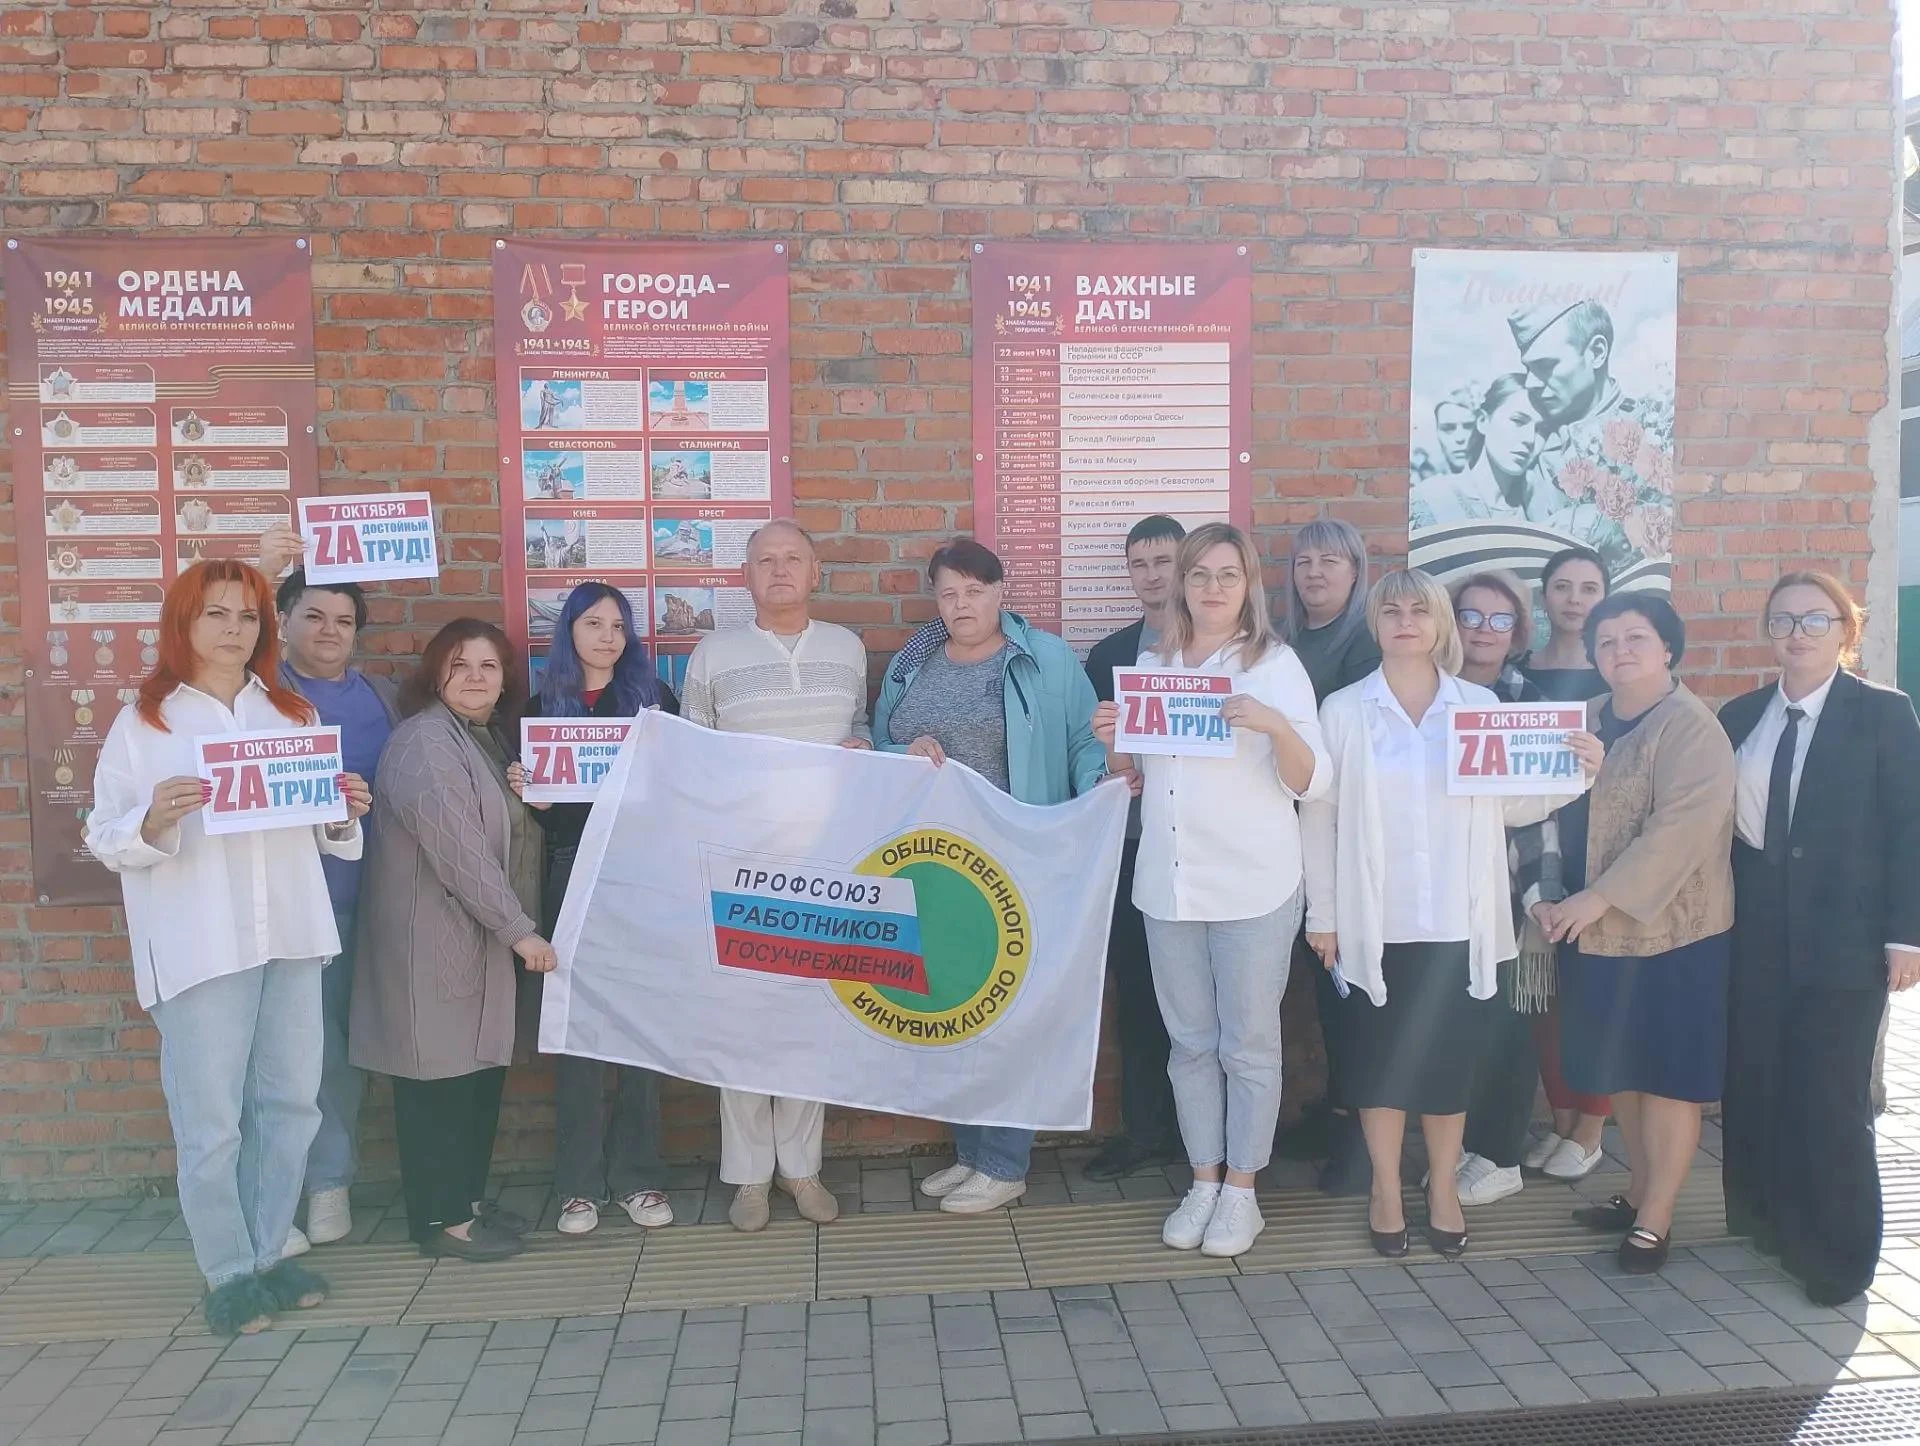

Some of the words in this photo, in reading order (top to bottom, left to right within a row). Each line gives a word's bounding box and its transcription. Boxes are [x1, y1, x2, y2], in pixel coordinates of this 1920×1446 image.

[45, 271, 92, 288] 1941
[118, 270, 244, 295] ОРДЕНА
[1008, 276, 1051, 292] 1941
[1076, 276, 1195, 295] ВАЖНЫЕ
[45, 298, 93, 315] 1945
[119, 296, 252, 320] МЕДАЛИ
[603, 300, 688, 319] ГЕРОИ
[1008, 301, 1052, 317] 1945
[1076, 300, 1151, 324] ДАТЫ
[119, 321, 166, 330] ВЕЛИКОЙ
[170, 321, 253, 330] ОТЕЧЕСТВЕННОЙ
[258, 321, 295, 330] ВОЙНЫ
[604, 322, 649, 331] ВЕЛИКОЙ
[651, 322, 730, 331] ОТЕЧЕСТВЕННОЙ
[734, 322, 768, 331] ВОЙНЫ
[1075, 324, 1118, 333] ВЕЛИКОЙ
[1121, 324, 1194, 333] ОТЕЧЕСТВЕННОЙ
[1198, 324, 1230, 332] ВОЙНЫ
[523, 339, 550, 350] 1941
[561, 339, 590, 350] 1945
[1068, 345, 1112, 353] Нападение
[1114, 345, 1162, 353] фашистской
[552, 370, 609, 379] ЛЕНИНГРАД
[689, 371, 726, 380] ОДЕССА
[1068, 367, 1119, 375] Героическая
[1122, 367, 1156, 375] оборона
[1112, 375, 1149, 383] крепости
[1069, 392, 1119, 400] Смоленское
[1069, 414, 1118, 422] Героическая
[1120, 414, 1152, 422] оборона
[1154, 414, 1184, 422] Одессы
[549, 440, 616, 449] СЕВАСТОПОЛЬ
[679, 441, 740, 449] СТАЛИНГРАД
[1104, 435, 1155, 443] Ленинграда
[1106, 456, 1137, 465] Москву
[1069, 478, 1121, 486] Героическая
[1161, 477, 1214, 485] Севастополя
[328, 507, 336, 519] 7
[342, 503, 406, 519] ОКТЯБРЯ
[1069, 500, 1109, 508] Ржевская
[572, 510, 597, 518] КИЕВ
[698, 509, 725, 517] БРЕСТ
[362, 519, 428, 536] ДОСТОЙНЫЙ
[312, 525, 364, 565] ZA
[362, 538, 431, 563] ТРУД!
[1068, 543, 1108, 551] Сражение
[1068, 564, 1128, 572] Сталинградск
[699, 577, 728, 585] КЕРЧЬ
[1105, 605, 1144, 613] Правобер
[1069, 626, 1108, 634] Открытие
[1140, 676, 1148, 689] 7
[1151, 676, 1210, 690] ОКТЯБРЯ
[1168, 696, 1224, 709] ДОСТОЙНЫ
[1124, 696, 1167, 735] ZA
[1478, 714, 1486, 727] 7
[1491, 713, 1558, 727] ОКТЯБРЯ
[550, 728, 556, 739] 7
[562, 727, 622, 739] ОКТЯБРЯ
[1169, 713, 1231, 741] ТРУД!
[1510, 732, 1566, 746] ДОСТОЙН
[230, 744, 238, 758] 7
[245, 738, 314, 756] ОКТЯБРЯ
[578, 744, 620, 757] ДОСТОЙ
[1458, 735, 1508, 776] ZA
[268, 756, 338, 776] ДОСТОЙНЫЙ
[532, 747, 577, 784] ZA
[1510, 751, 1580, 778] ТРУД!
[212, 764, 268, 812] ZA
[268, 777, 340, 807] ТРУД!
[734, 868, 881, 905] ПРОФСОЮЗ
[882, 837, 1024, 957] ОБЩЕСТВЕННОГО
[728, 903, 898, 942] РАБОТНИКОВ
[724, 939, 914, 982] ГОСУЧРЕЖДЕНИЙ
[852, 970, 1016, 1038] ОБСЛУЖИВАНИЯ
